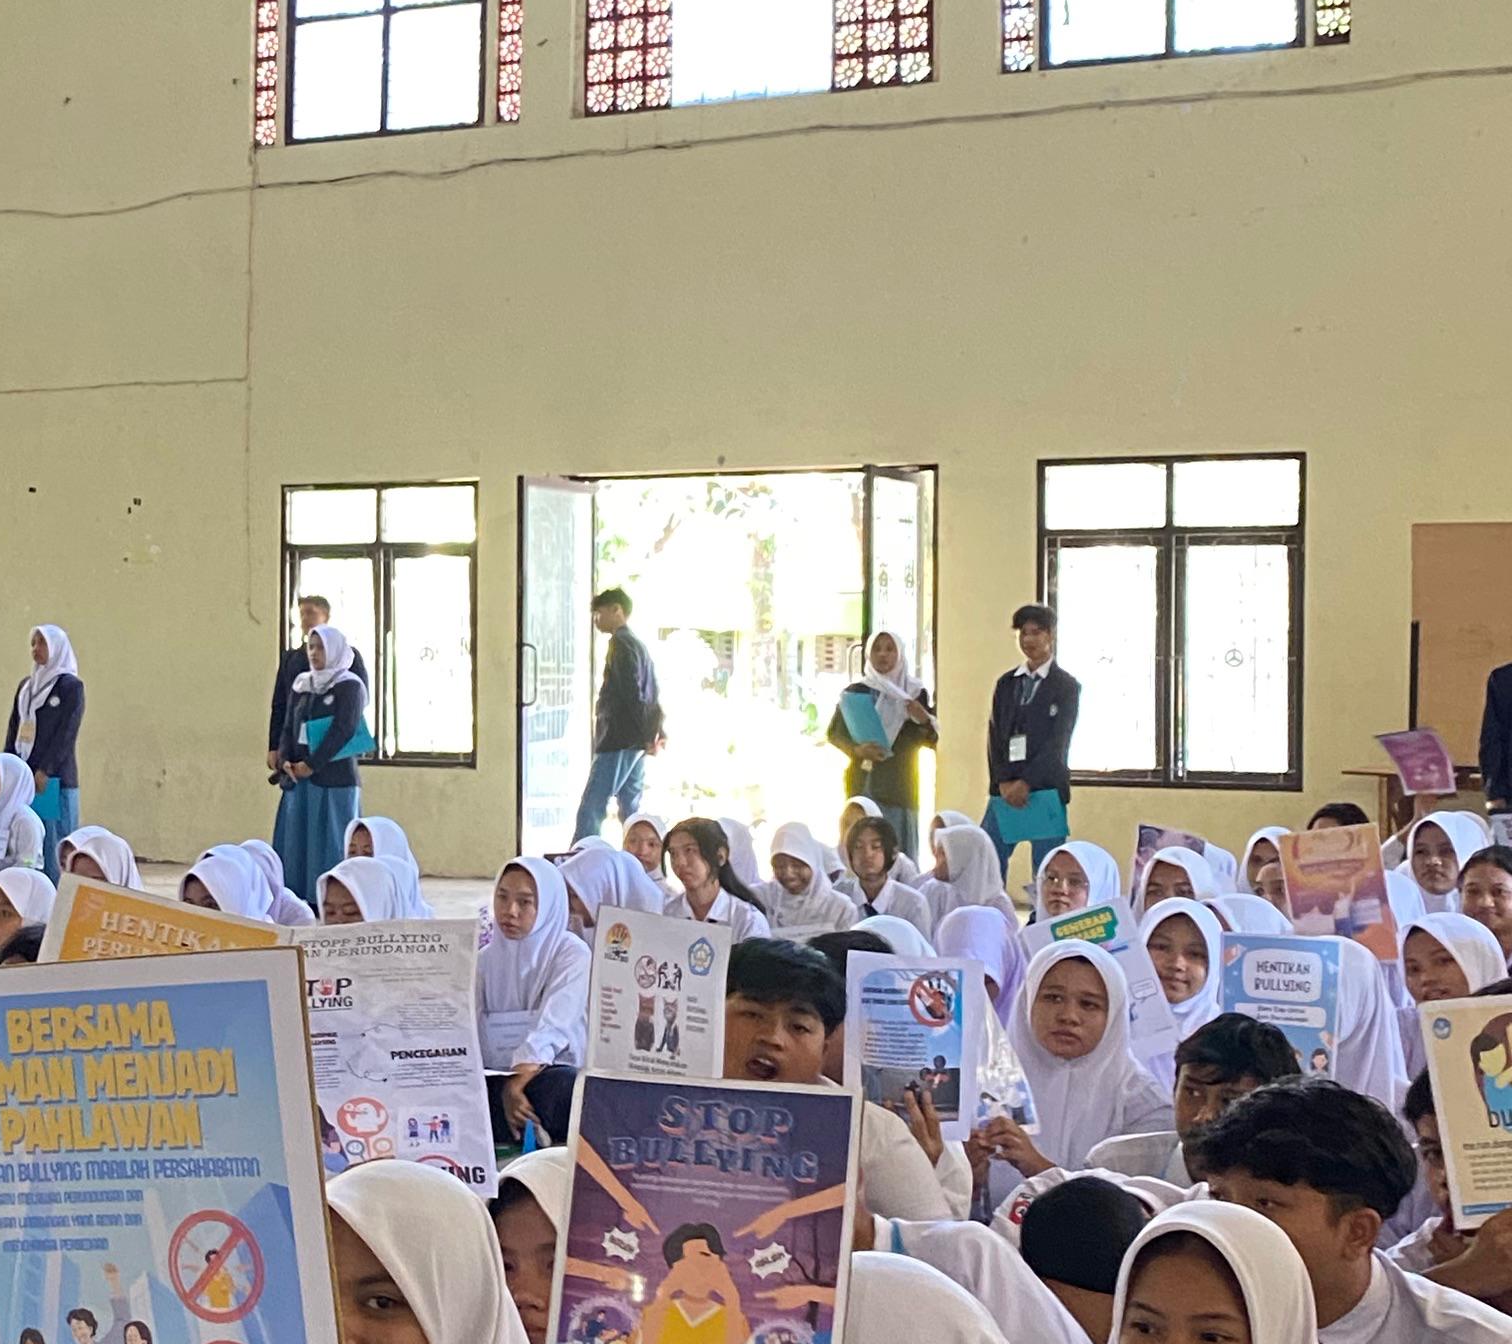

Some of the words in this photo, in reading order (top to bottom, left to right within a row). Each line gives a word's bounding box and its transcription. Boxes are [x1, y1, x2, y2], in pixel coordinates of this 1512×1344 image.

[100, 910, 240, 950] HENTIKA
[304, 949, 321, 958] AN
[1256, 960, 1311, 975] HENTIKAN
[1254, 977, 1312, 993] BULLYING
[311, 996, 353, 1009] LYING
[5, 1001, 177, 1056] BERSAMA
[390, 1047, 468, 1060] PENCEGAHAN
[84, 1047, 238, 1102] MENJADI
[0, 1101, 203, 1156] PAHLAWAN
[657, 1095, 794, 1145] STOP
[18, 1161, 82, 1183] BULLYING
[153, 1156, 261, 1179] PERSAHABATAN
[607, 1136, 819, 1184] BULLYING
